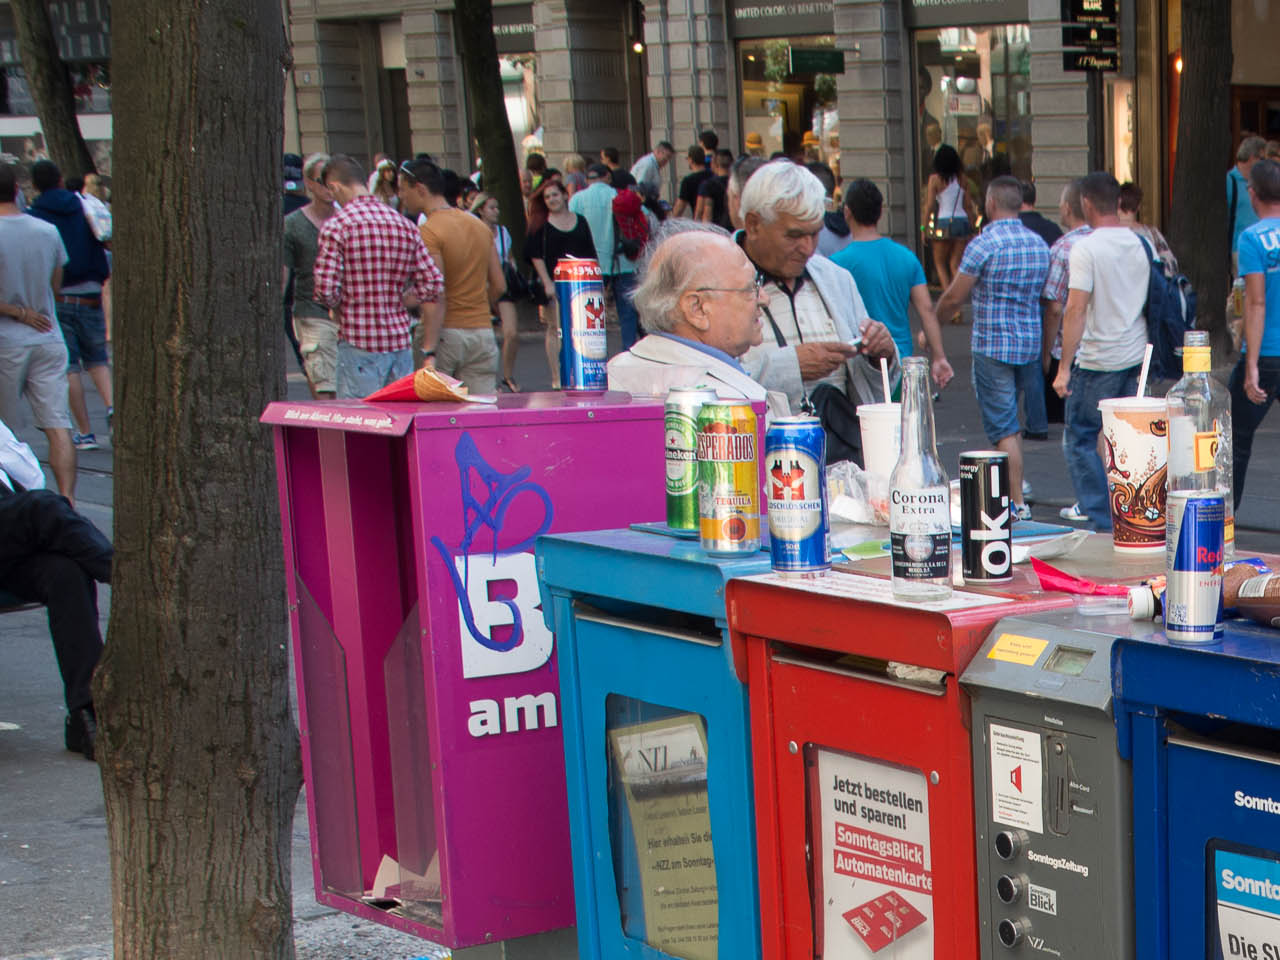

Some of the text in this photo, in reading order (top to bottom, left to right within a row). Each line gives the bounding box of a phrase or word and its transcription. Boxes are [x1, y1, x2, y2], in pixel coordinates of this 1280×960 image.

[716, 496, 753, 506] TEQUILA
[891, 490, 945, 505] Corona
[901, 505, 936, 515] Extra
[1196, 546, 1224, 564] Red
[466, 691, 558, 738] am
[833, 775, 923, 814] Jetzt bestellen
[833, 798, 907, 830] und sparen!
[837, 826, 923, 864] SonntagsBlick
[836, 853, 933, 891] Automatenkarte
[1027, 850, 1089, 877] SonntagsZeitung
[1030, 893, 1055, 913] Blick
